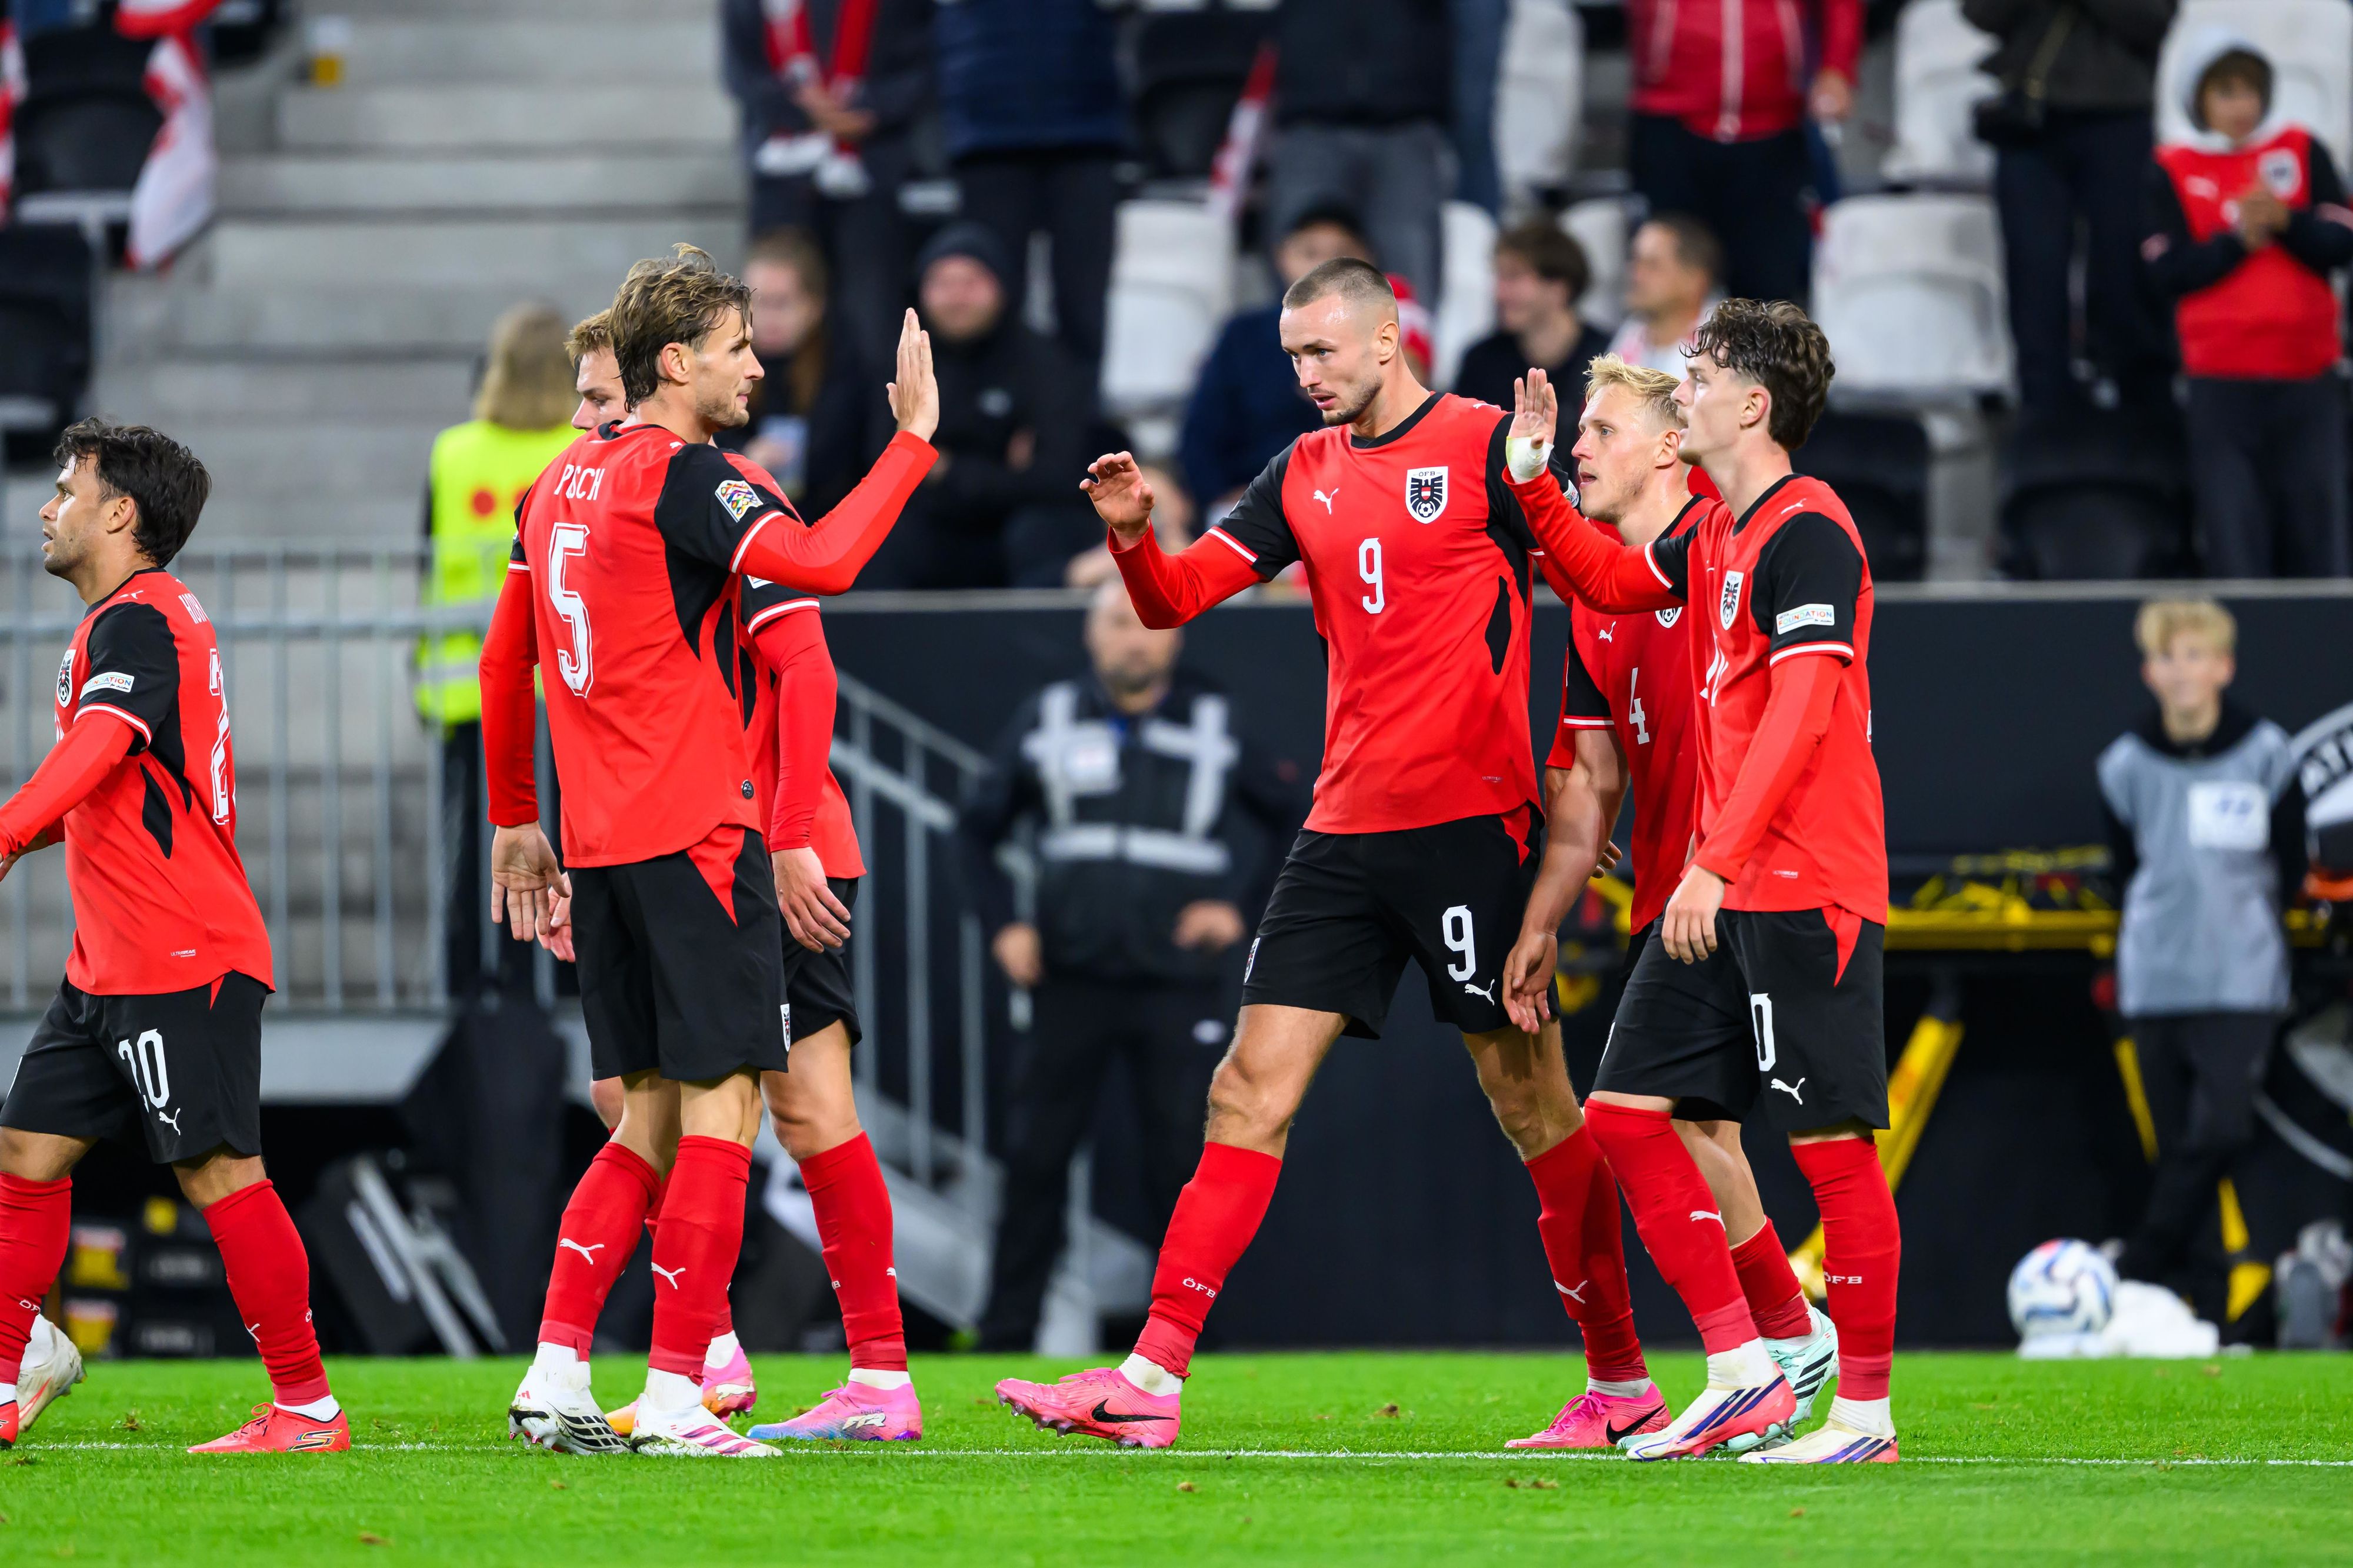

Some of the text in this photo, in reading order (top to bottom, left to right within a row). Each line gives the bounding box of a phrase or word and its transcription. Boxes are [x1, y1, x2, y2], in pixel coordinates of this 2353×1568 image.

[549, 522, 594, 699] 5
[1358, 538, 1385, 614] 9
[1778, 610, 1832, 626] FOUNDATION
[1629, 667, 1650, 745] 4
[1442, 905, 1476, 982] 9
[1182, 1277, 1216, 1299] ÖFB
